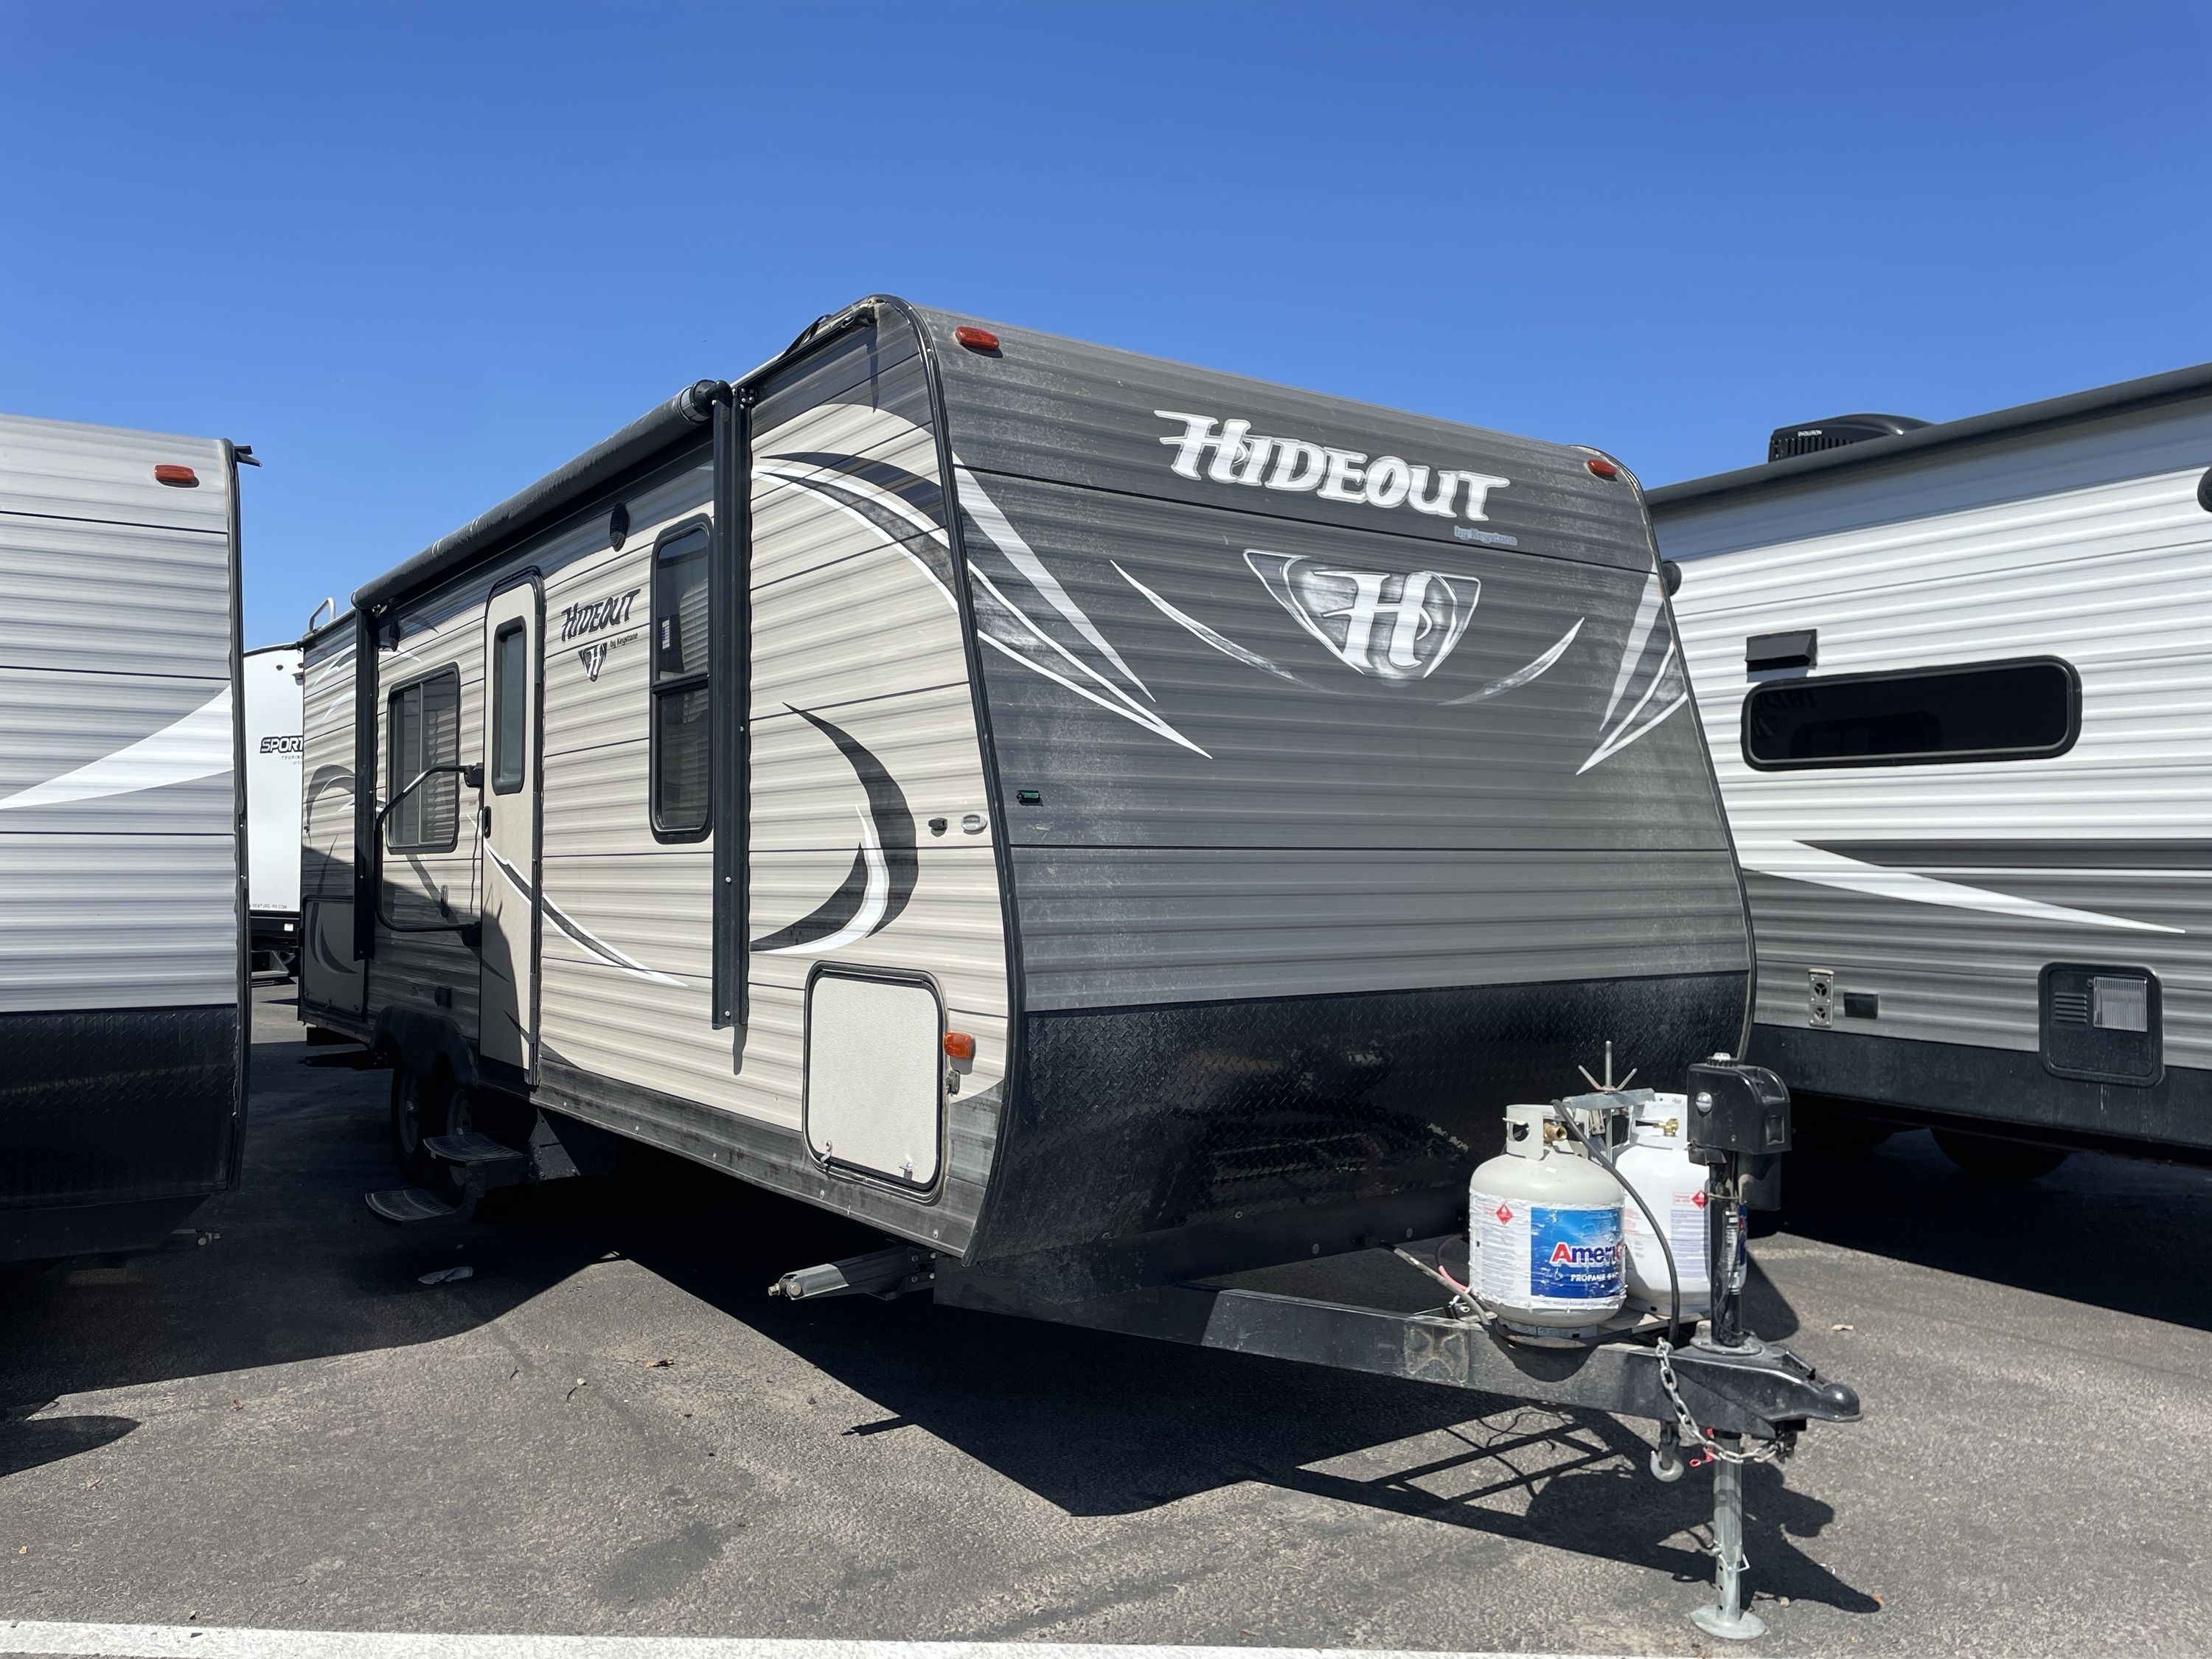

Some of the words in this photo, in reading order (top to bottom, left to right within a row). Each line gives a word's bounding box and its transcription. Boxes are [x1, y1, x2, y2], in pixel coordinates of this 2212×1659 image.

[1154, 409, 1510, 521] HIDEOUT
[561, 588, 641, 642] HIDEOUT
[611, 640, 616, 648] by
[617, 633, 638, 645] Keystone
